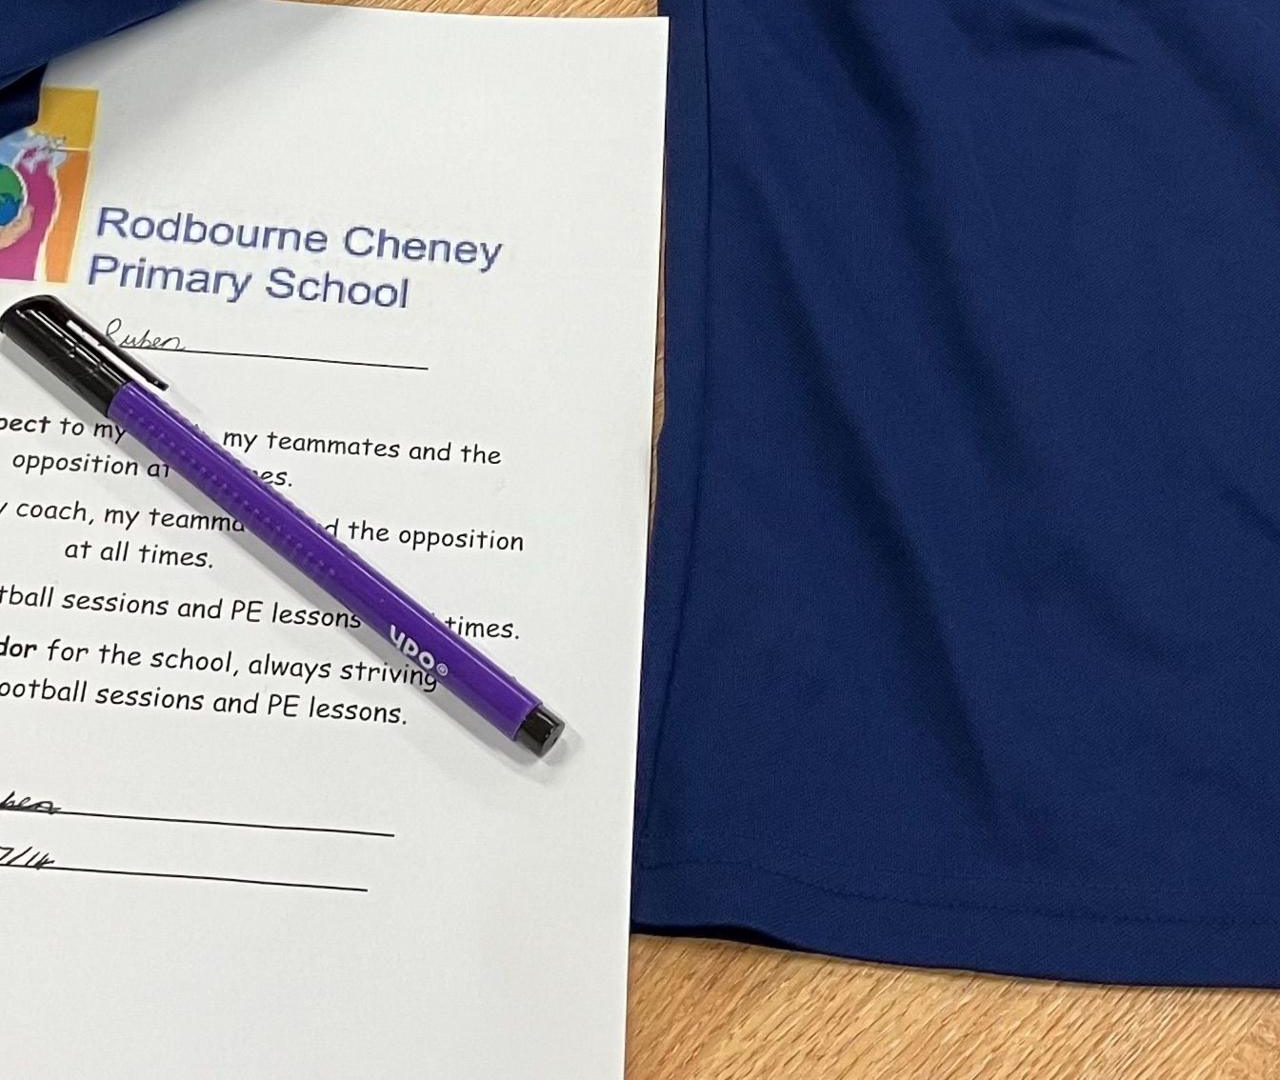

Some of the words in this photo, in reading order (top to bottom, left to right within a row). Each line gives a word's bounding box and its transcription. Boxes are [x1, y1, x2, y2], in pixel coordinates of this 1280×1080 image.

[97, 207, 328, 264] Rodbourne
[344, 226, 503, 274] Cheney
[88, 254, 253, 303] Primary
[265, 267, 409, 308] School
[12, 453, 138, 476] opposition
[59, 417, 85, 436] to
[93, 422, 126, 444] my
[223, 431, 258, 453] my
[266, 431, 400, 458] teammates
[409, 441, 452, 461] and
[460, 443, 501, 465] the
[16, 500, 94, 526] coach,
[104, 508, 140, 531] my
[148, 508, 245, 534] teamma
[348, 519, 390, 542] the
[399, 529, 523, 552] opposition
[64, 540, 93, 559] at
[100, 540, 129, 562] all
[138, 544, 213, 569] times.
[61, 592, 169, 616] sessions
[177, 598, 223, 619] and
[231, 599, 264, 623] PE
[272, 601, 361, 632] lessons
[445, 614, 520, 641] times.
[47, 638, 89, 662] for
[98, 643, 142, 666] the
[150, 647, 239, 677] school,
[248, 653, 332, 685] always
[339, 661, 438, 694] striving
[94, 686, 205, 711] sessions
[213, 692, 260, 714] and
[267, 693, 301, 718] PE
[309, 695, 407, 725] lessons.
